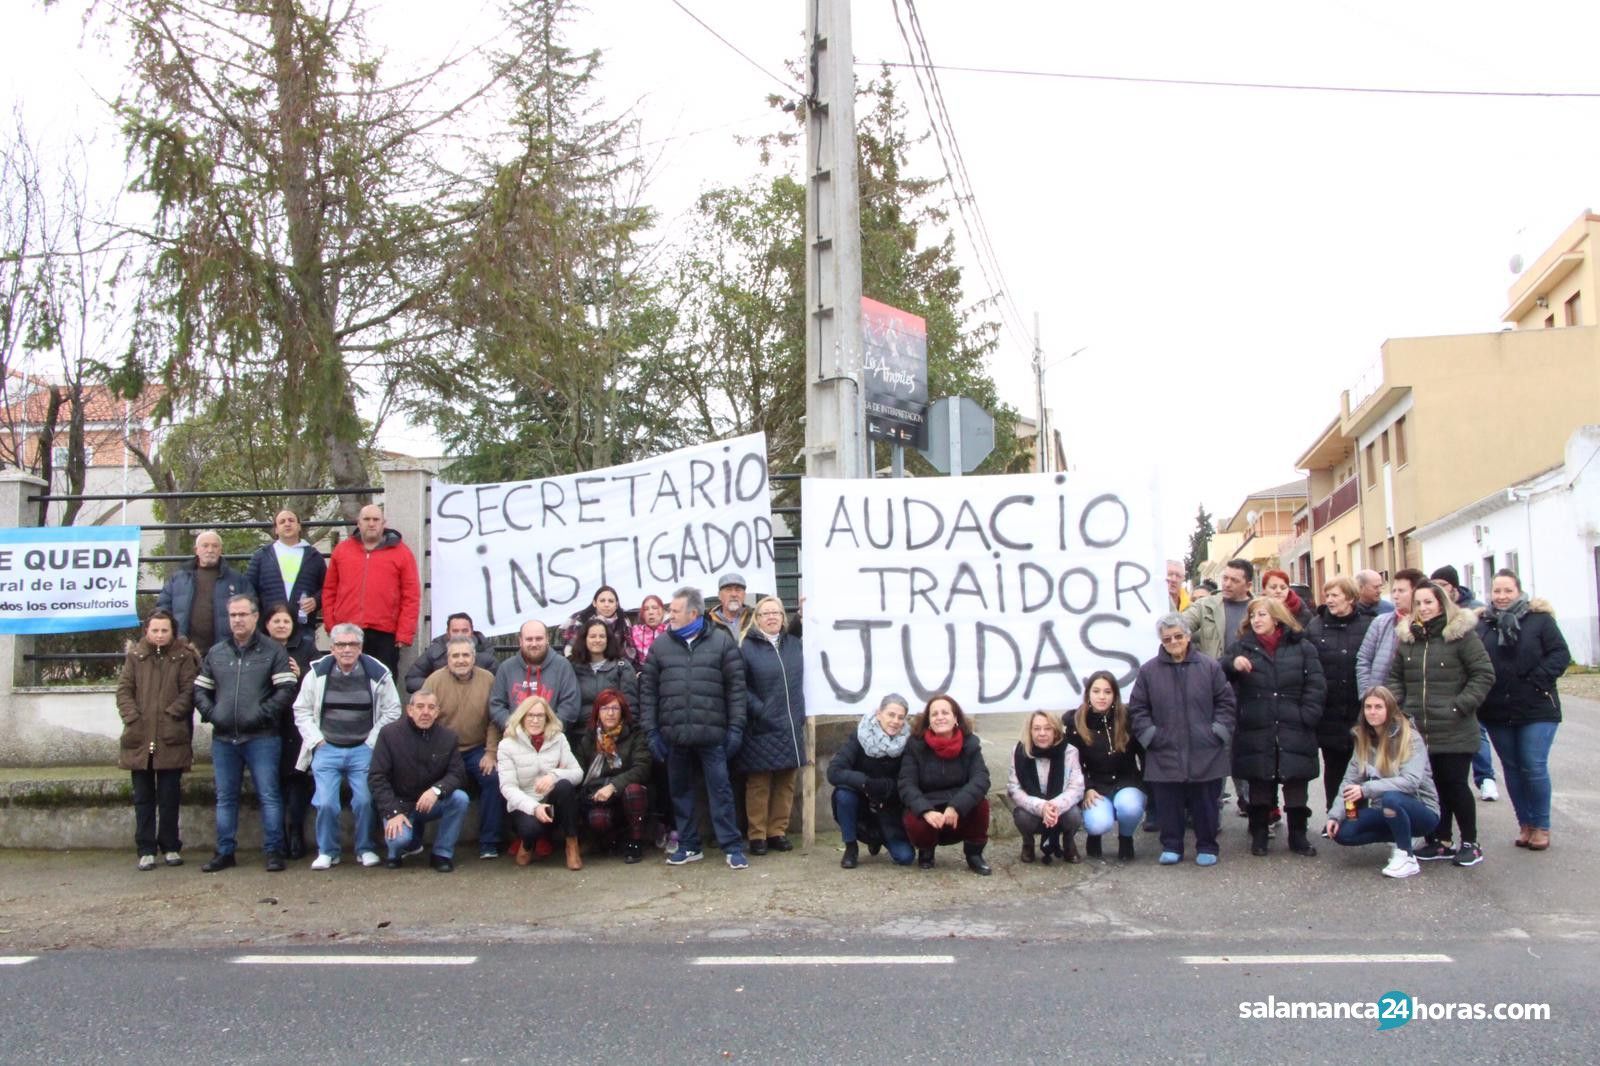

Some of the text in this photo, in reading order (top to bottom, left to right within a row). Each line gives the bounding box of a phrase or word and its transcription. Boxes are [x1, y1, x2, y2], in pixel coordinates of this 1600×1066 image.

[24, 548, 132, 571] QUEDA
[31, 578, 53, 591] de
[60, 578, 76, 590] la
[84, 577, 127, 592] JCyL
[0, 598, 129, 611] dos los consultorios
[820, 613, 1140, 704] JUDAS
